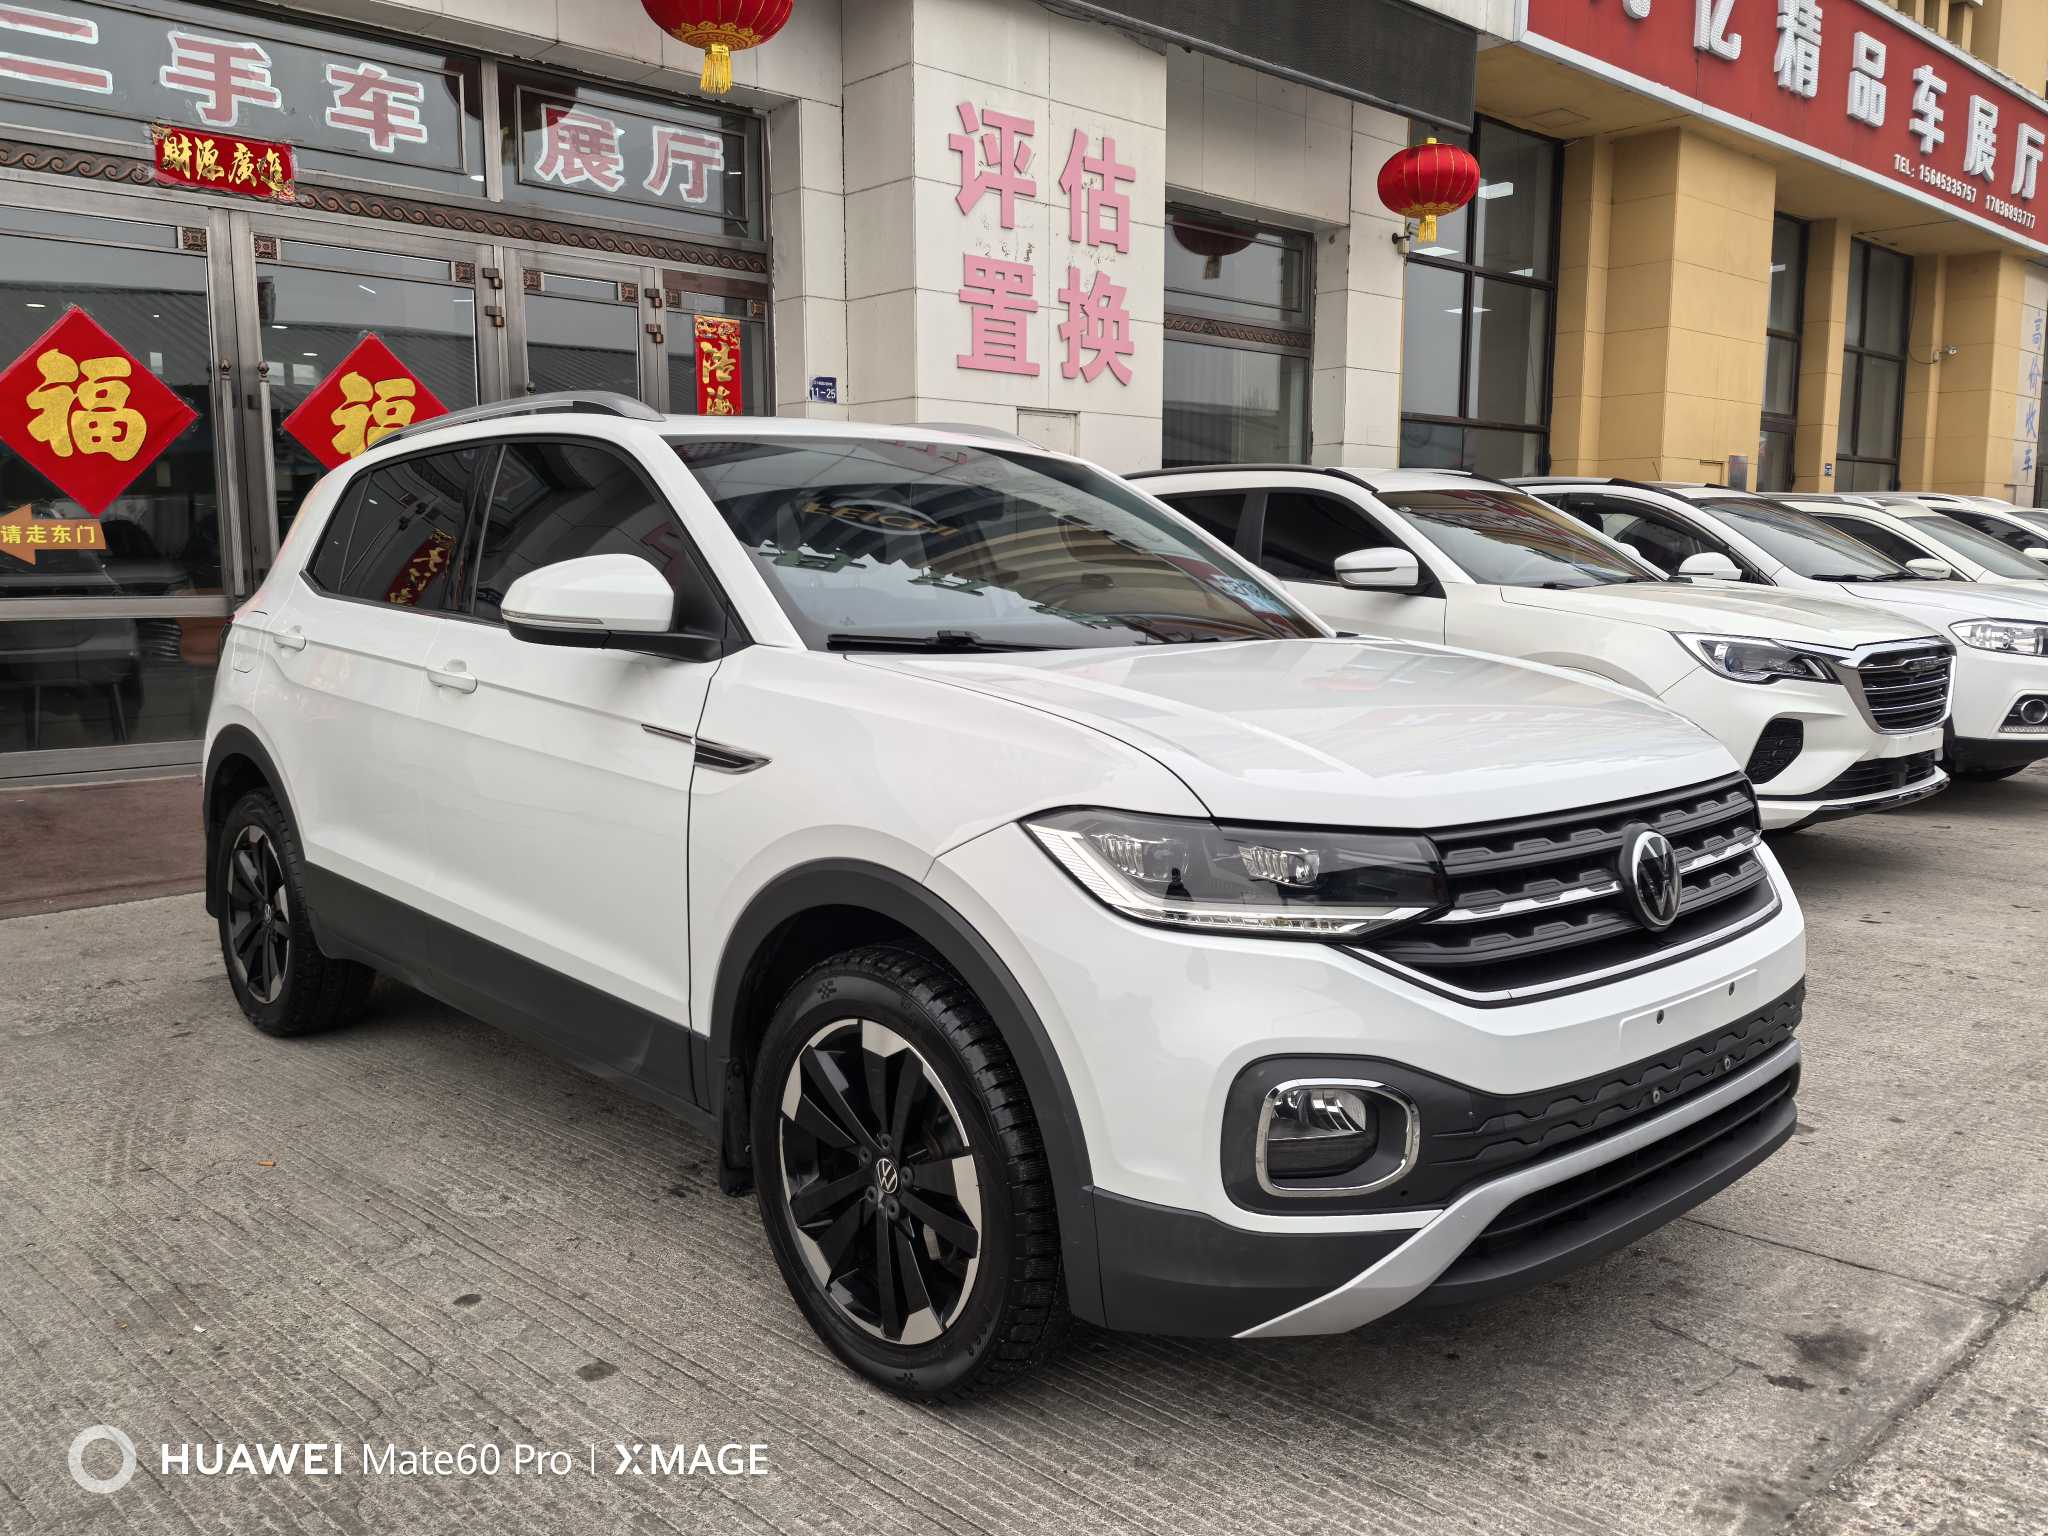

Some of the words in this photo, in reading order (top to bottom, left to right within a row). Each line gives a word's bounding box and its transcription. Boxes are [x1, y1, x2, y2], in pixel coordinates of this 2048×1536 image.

[1589, 0, 2046, 200] 亿精品车展厅
[948, 101, 1137, 254] 评估
[1919, 164, 1977, 203] 15645335757
[956, 253, 1136, 387] 置换
[26, 349, 147, 461] 福
[331, 372, 416, 457] 福
[1, 524, 96, 545] 请走东门
